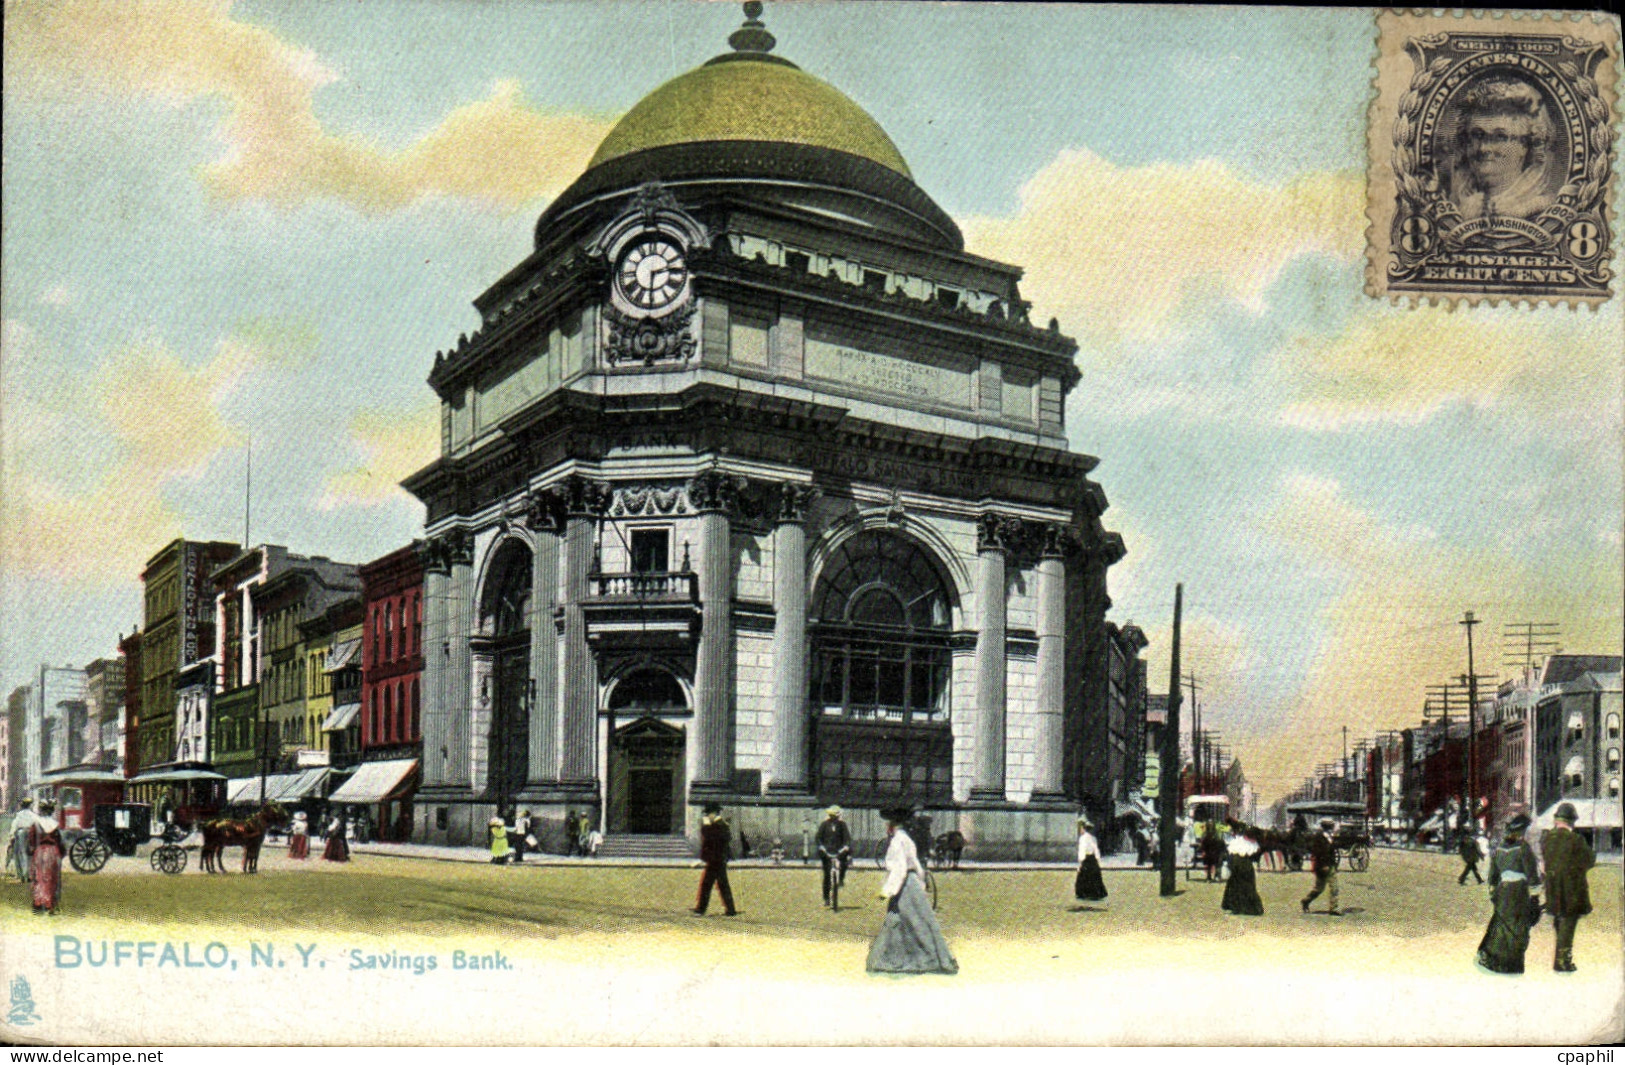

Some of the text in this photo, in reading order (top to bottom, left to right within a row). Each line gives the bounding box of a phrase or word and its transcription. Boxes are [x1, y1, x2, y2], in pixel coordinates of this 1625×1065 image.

[1446, 53, 1520, 88] STATES
[1521, 56, 1550, 78] OF
[1546, 76, 1584, 172] AMERICA
[1547, 205, 1576, 222] 1802
[1402, 215, 1431, 254] 8
[1455, 220, 1547, 244] MARTHA WASHINGTON
[1569, 221, 1600, 259] 8
[1452, 254, 1548, 267] POSTAGE
[1425, 266, 1577, 283] EIGHT CENTS
[620, 431, 677, 450] BANK
